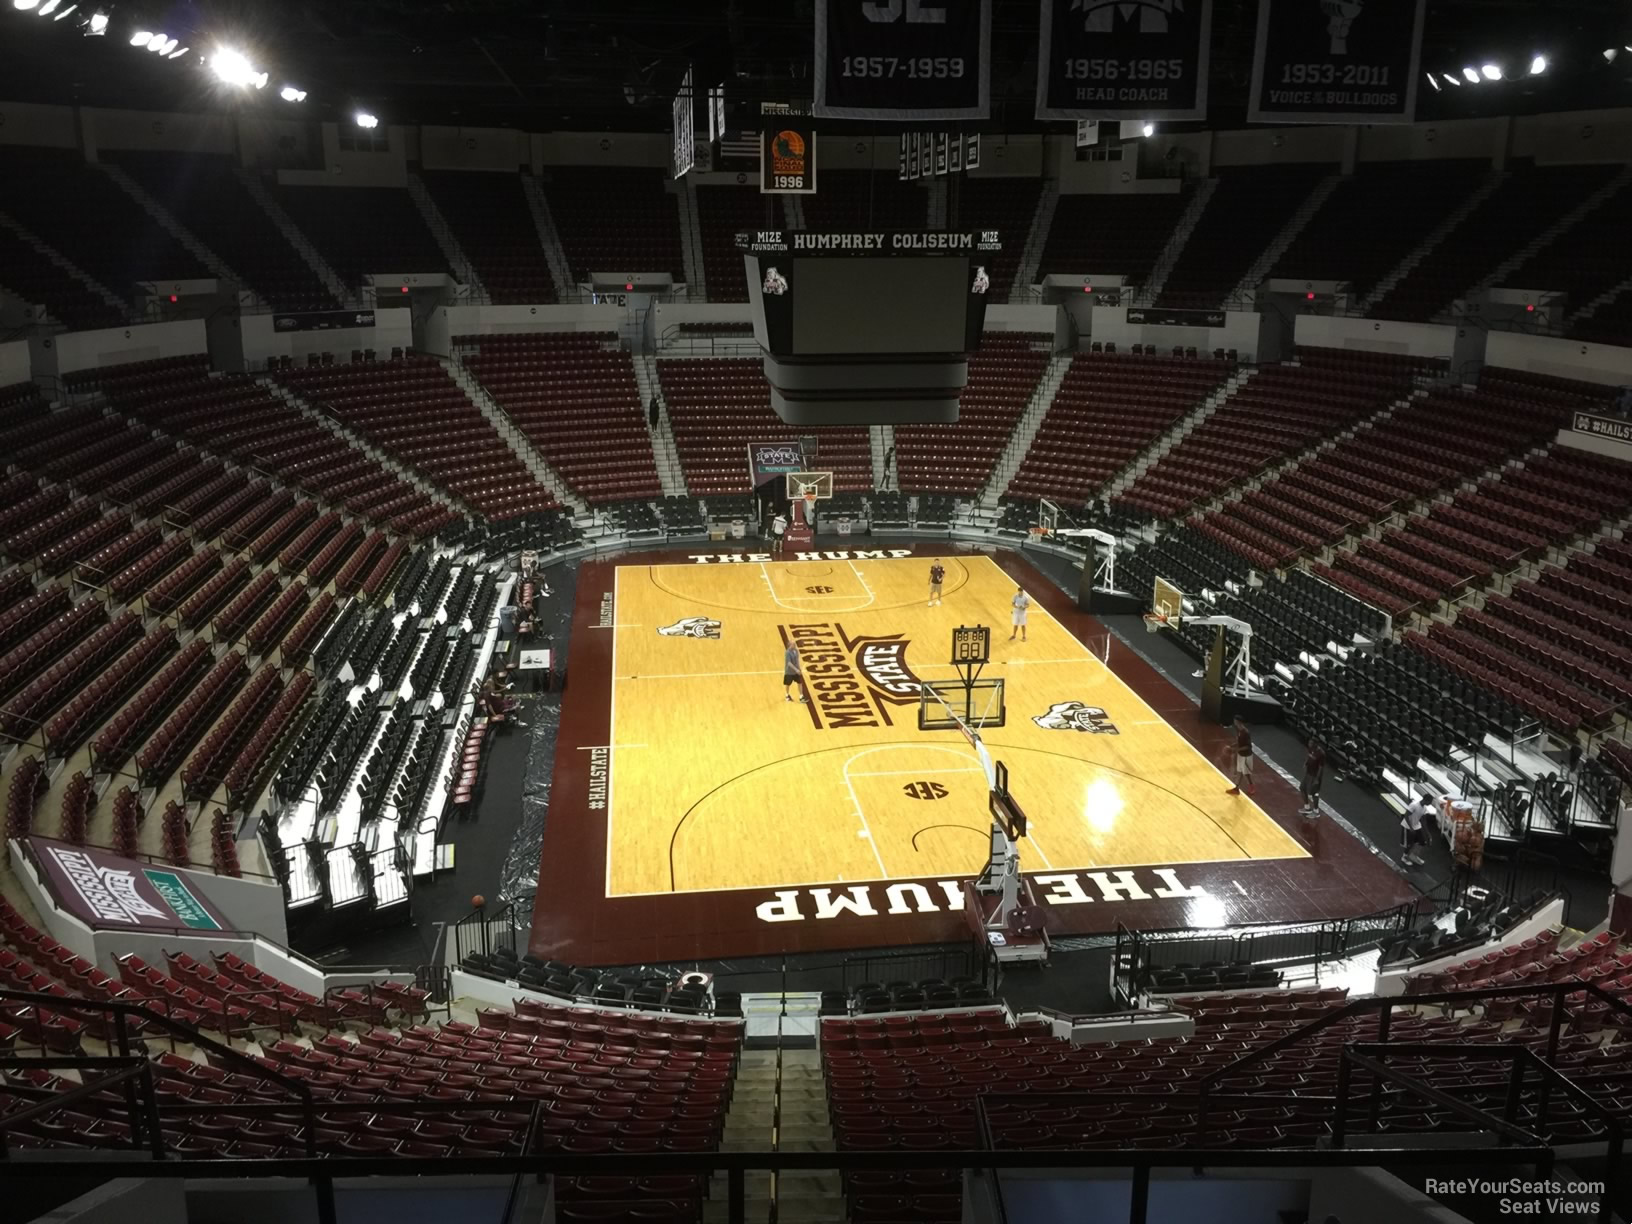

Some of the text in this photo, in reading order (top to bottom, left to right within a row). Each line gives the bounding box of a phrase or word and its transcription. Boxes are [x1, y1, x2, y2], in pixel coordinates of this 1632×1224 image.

[842, 57, 964, 78] 1957-1959
[1064, 58, 1183, 80] 1956-1965
[1281, 63, 1390, 86] 1953-2011
[1076, 87, 1168, 101] HEAD COACH
[1269, 89, 1312, 104] VOICE
[1325, 90, 1398, 106] BULLDOGS
[774, 175, 803, 188] 1996
[757, 231, 782, 243] MIZE
[793, 233, 973, 249] HUMPHREY COLISEUM
[981, 231, 999, 243] MIZE
[751, 243, 788, 251] FOUNDATION
[688, 548, 913, 564] THE HUMP
[805, 585, 835, 595] SEC
[788, 622, 879, 730] MISSISSIPPI
[863, 644, 922, 693] STATE
[588, 748, 608, 810] #HAILSTATE
[903, 781, 950, 800] SEC
[53, 847, 132, 923] MISSISSIPPI
[108, 876, 152, 912] STATE
[1034, 867, 1208, 905] THE
